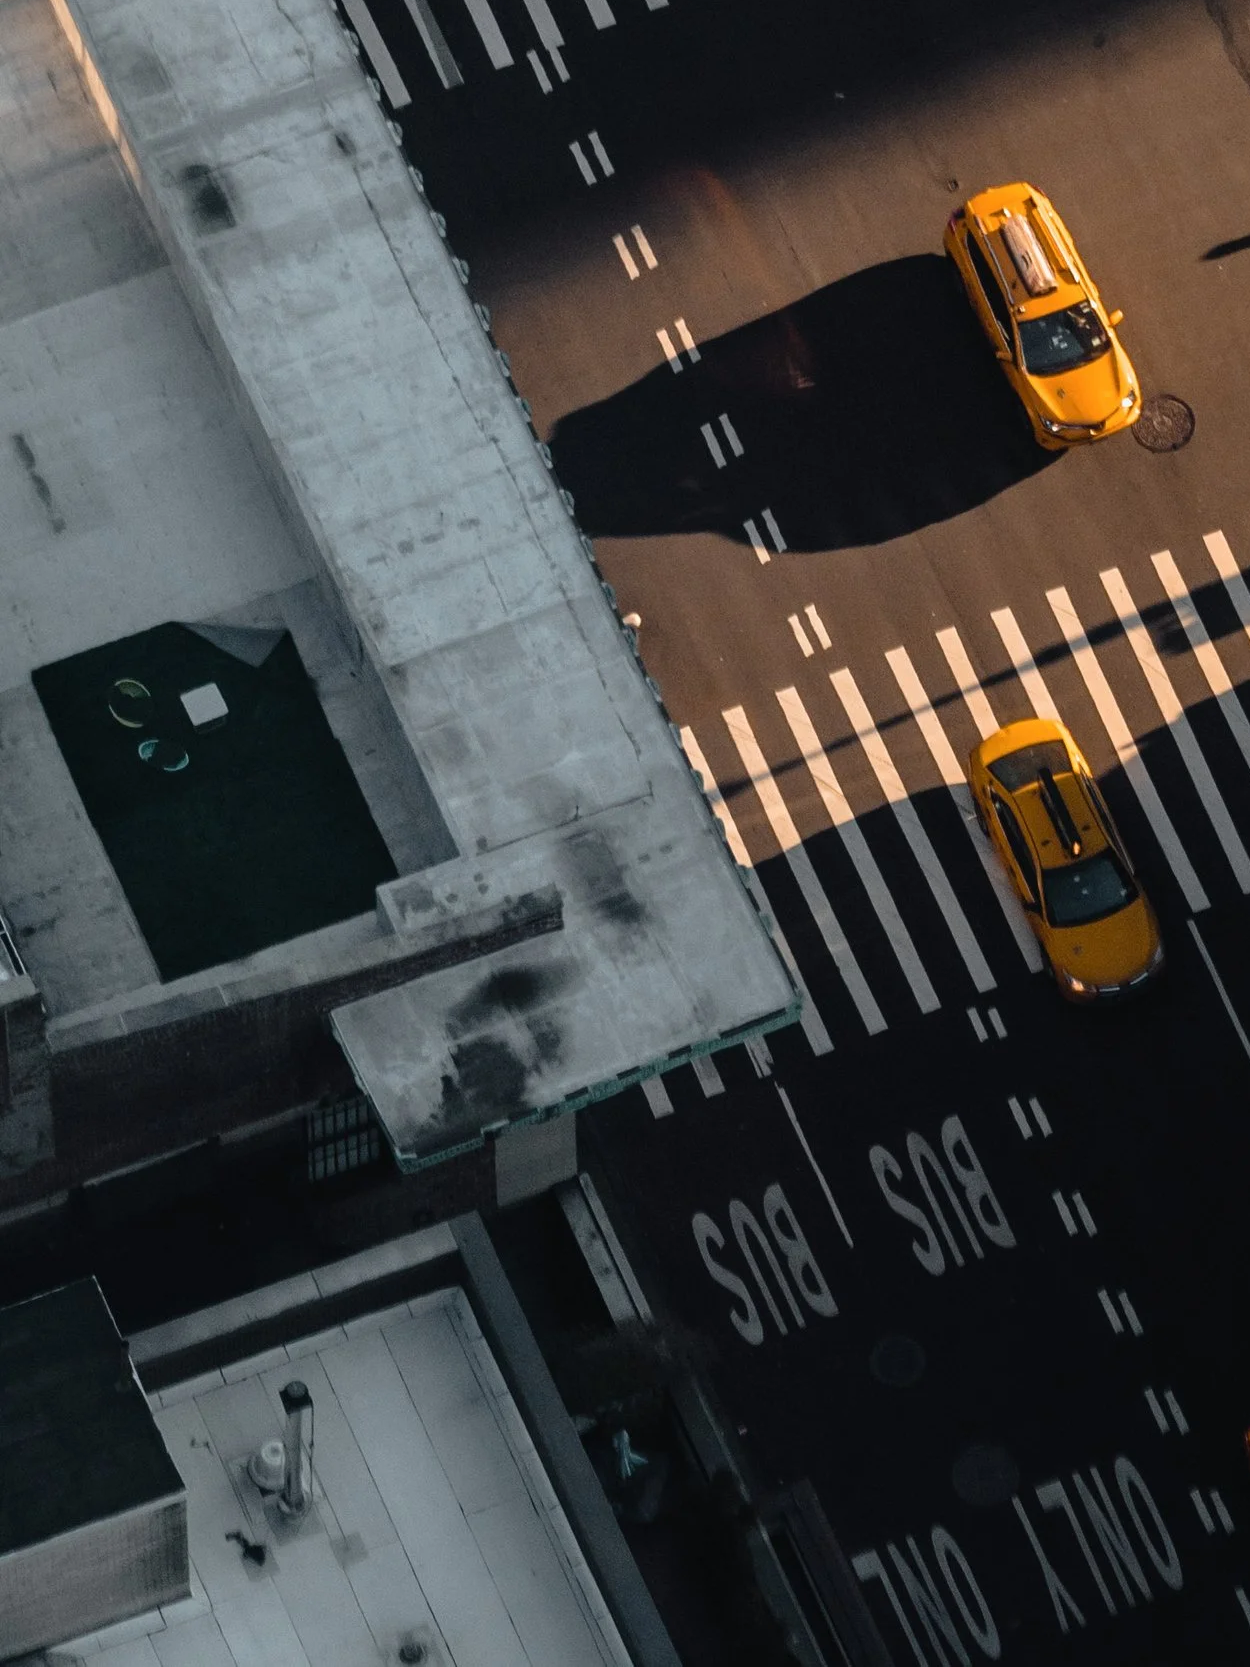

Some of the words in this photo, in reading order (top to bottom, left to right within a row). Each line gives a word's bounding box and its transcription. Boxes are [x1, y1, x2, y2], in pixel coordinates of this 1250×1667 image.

[691, 1182, 839, 1346] BUS
[868, 1114, 1017, 1276] BUS
[1011, 1456, 1184, 1632] ONLY
